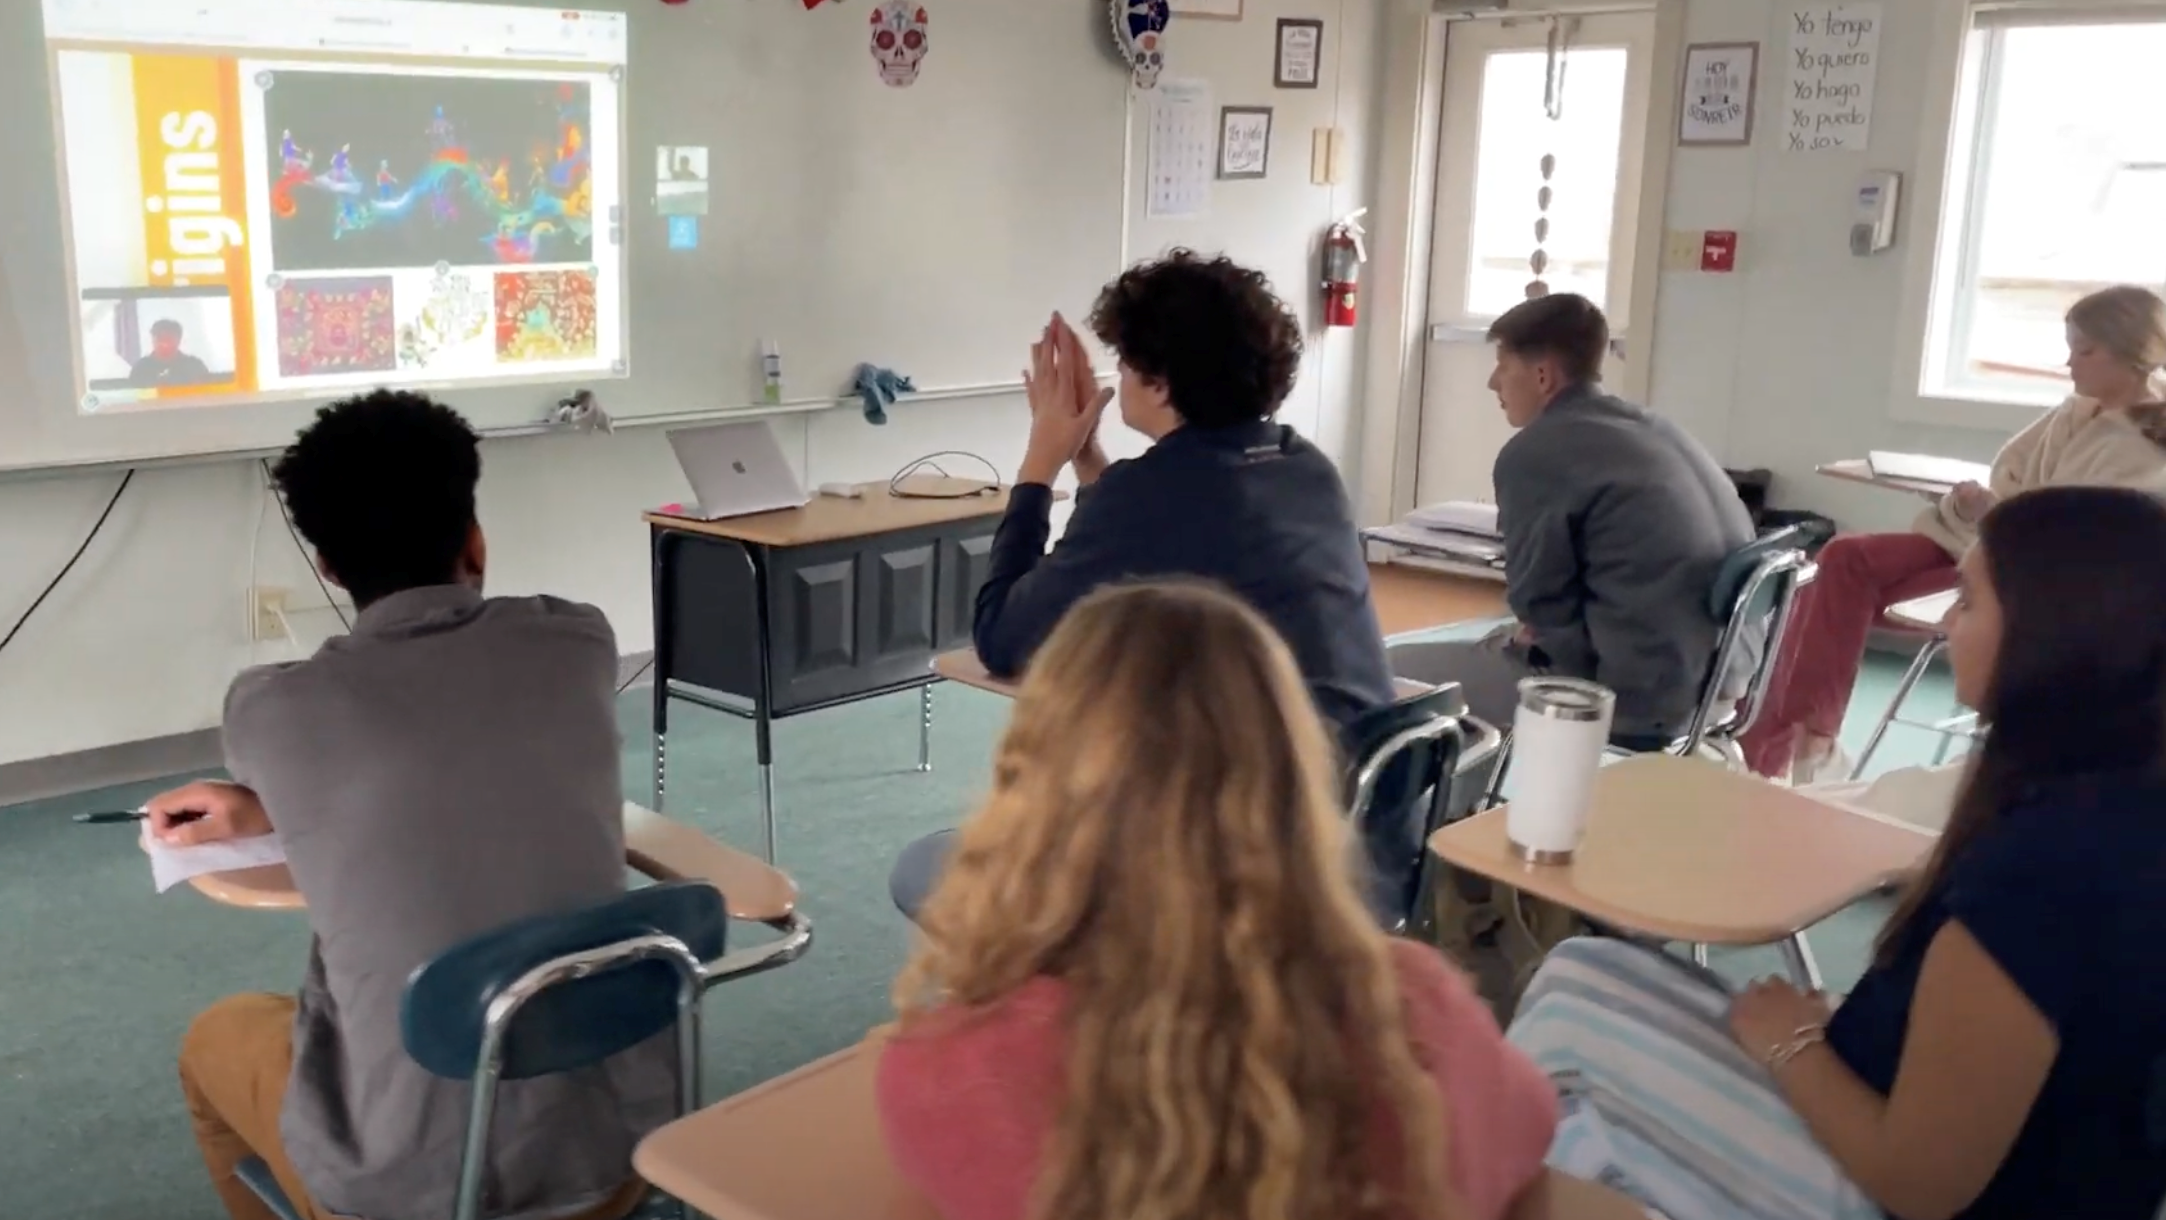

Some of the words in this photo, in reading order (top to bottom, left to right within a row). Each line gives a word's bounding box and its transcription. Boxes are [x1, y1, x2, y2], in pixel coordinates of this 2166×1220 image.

[1793, 11, 1814, 34] Yo
[1821, 9, 1873, 49] tengo
[1794, 47, 1814, 70] Yo
[1818, 52, 1869, 78] quiero
[1793, 80, 1813, 99] Yo
[1816, 79, 1860, 107] hago
[1793, 108, 1811, 128] Yo
[1816, 105, 1866, 133] puedo
[1789, 132, 1805, 151] Yo
[146, 110, 244, 286] igins
